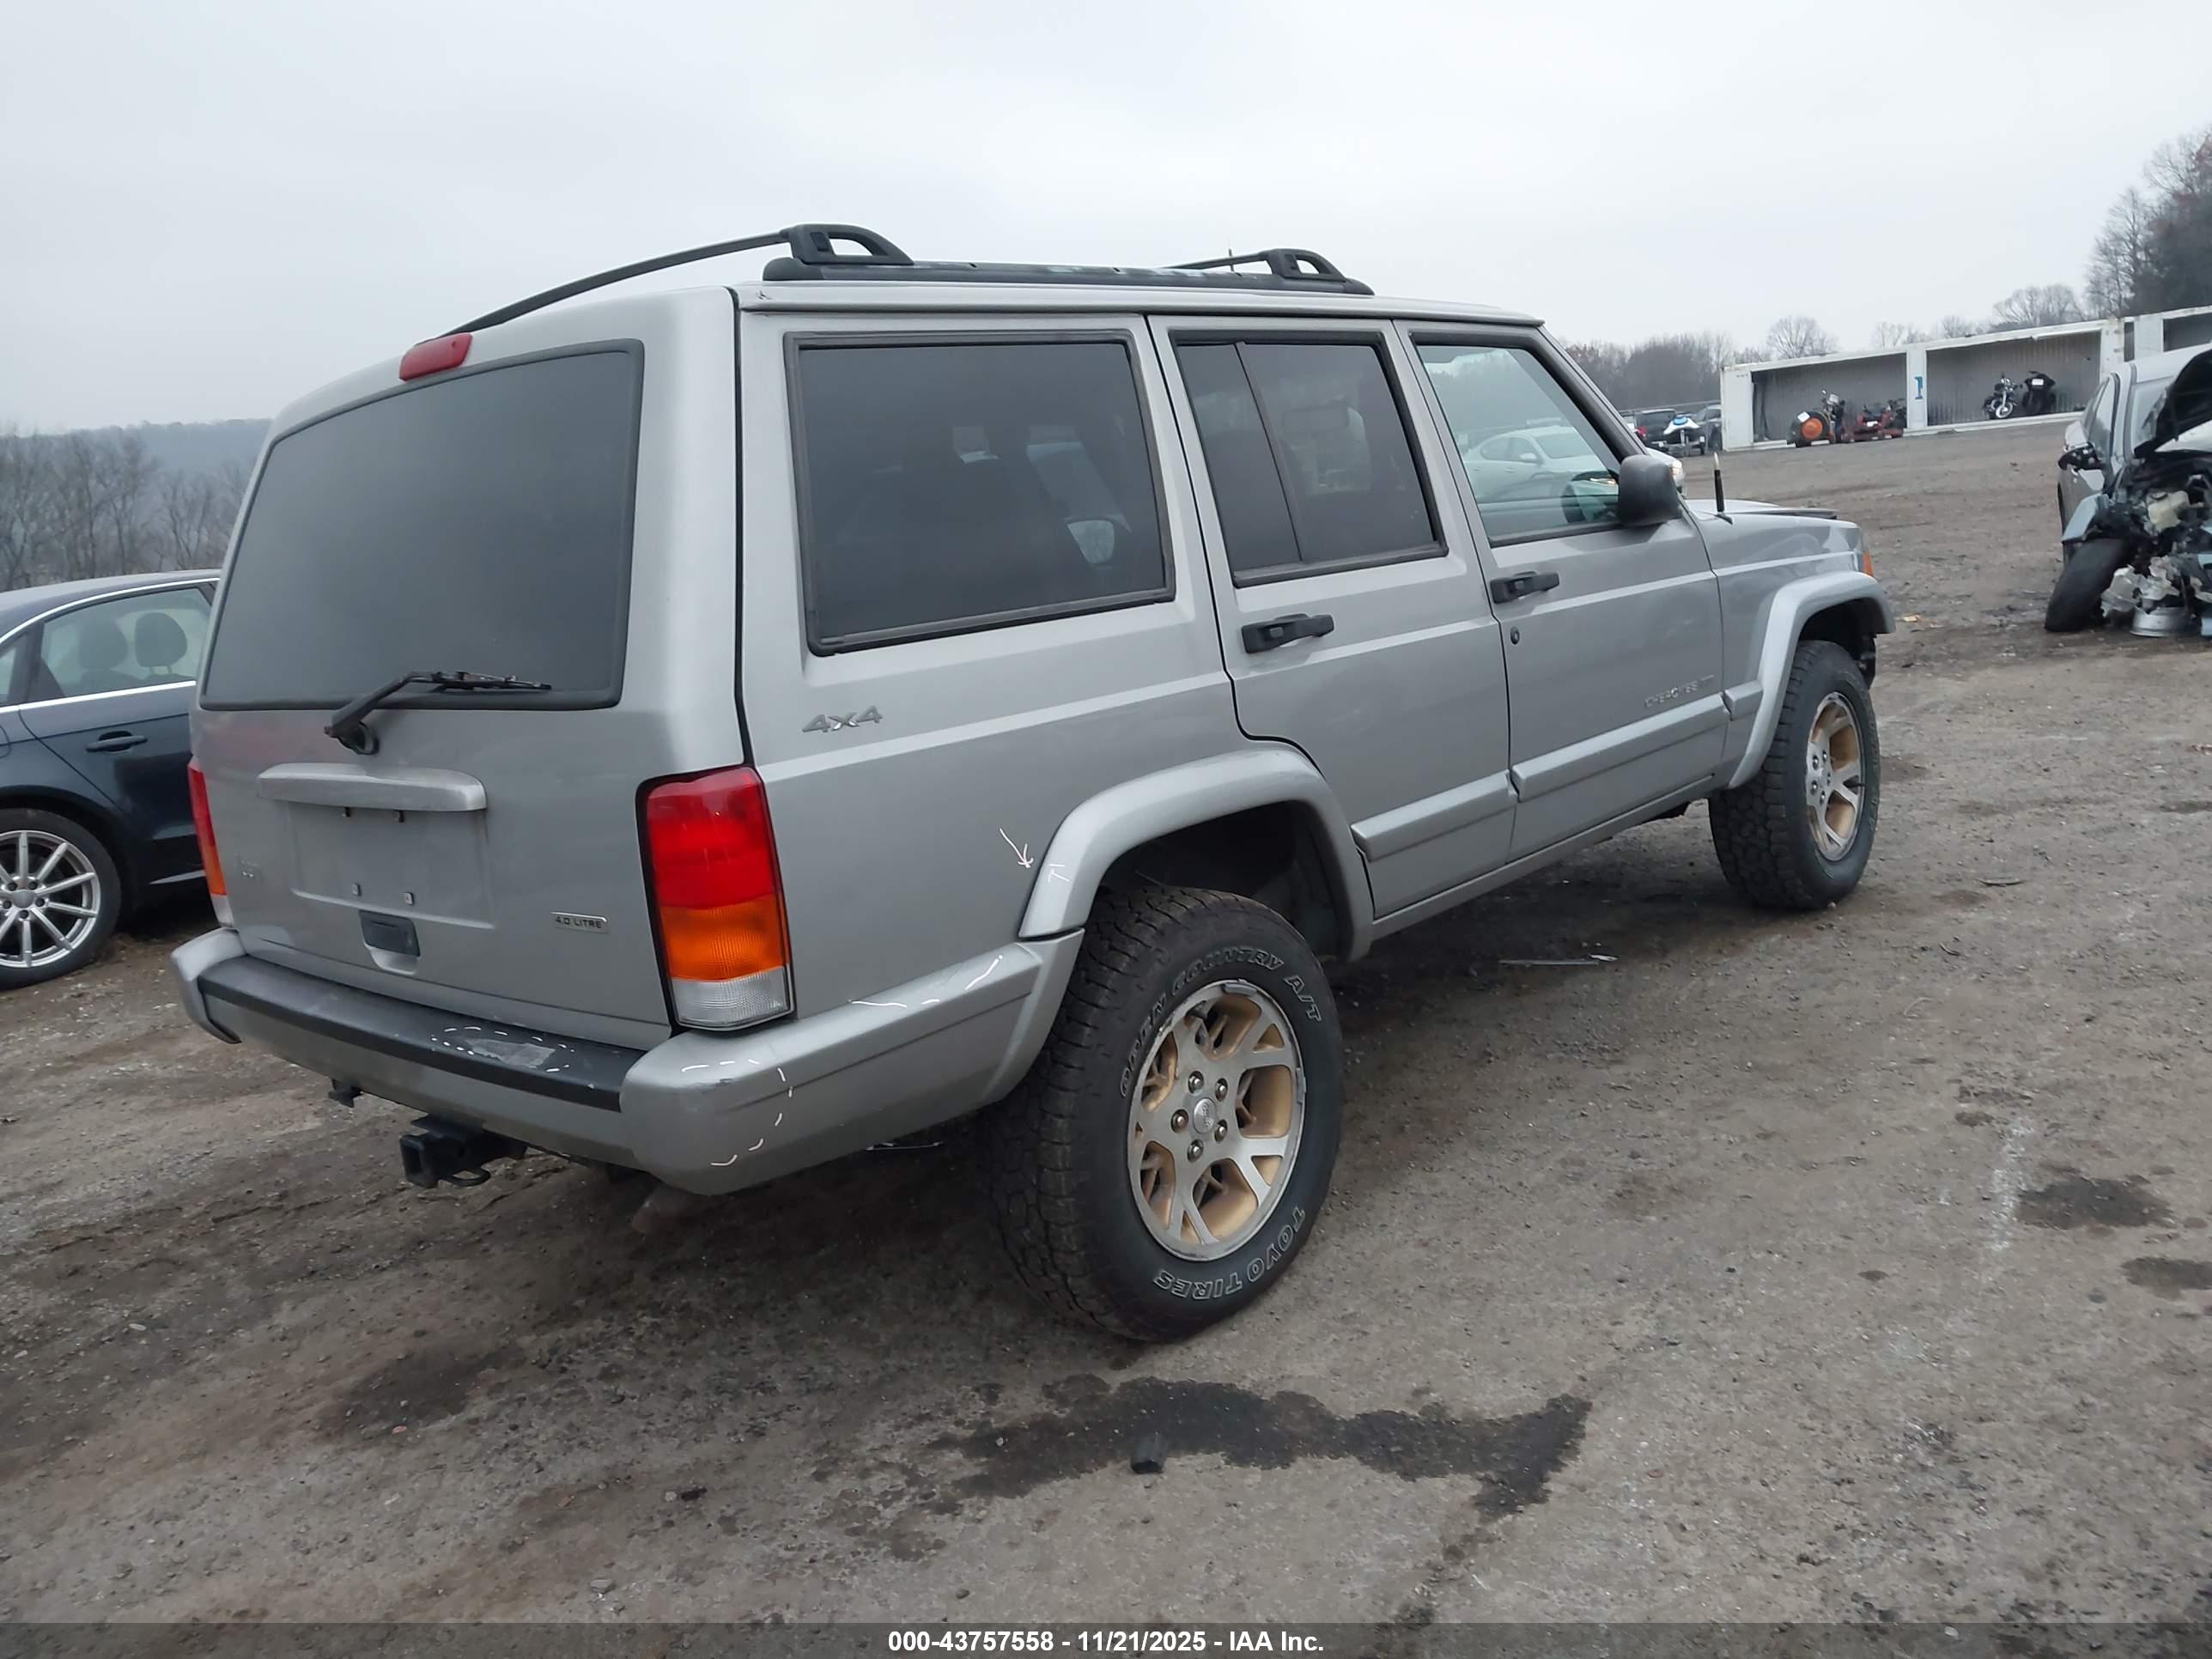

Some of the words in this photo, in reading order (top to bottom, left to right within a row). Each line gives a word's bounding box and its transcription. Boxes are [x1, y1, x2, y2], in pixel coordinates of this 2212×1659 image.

[573, 918, 603, 929] LITRE
[1172, 946, 1285, 996] COUNTRY
[1284, 975, 1322, 1022] A/T
[1247, 1206, 1305, 1283] TOYO
[1153, 1269, 1243, 1300] TIRES
